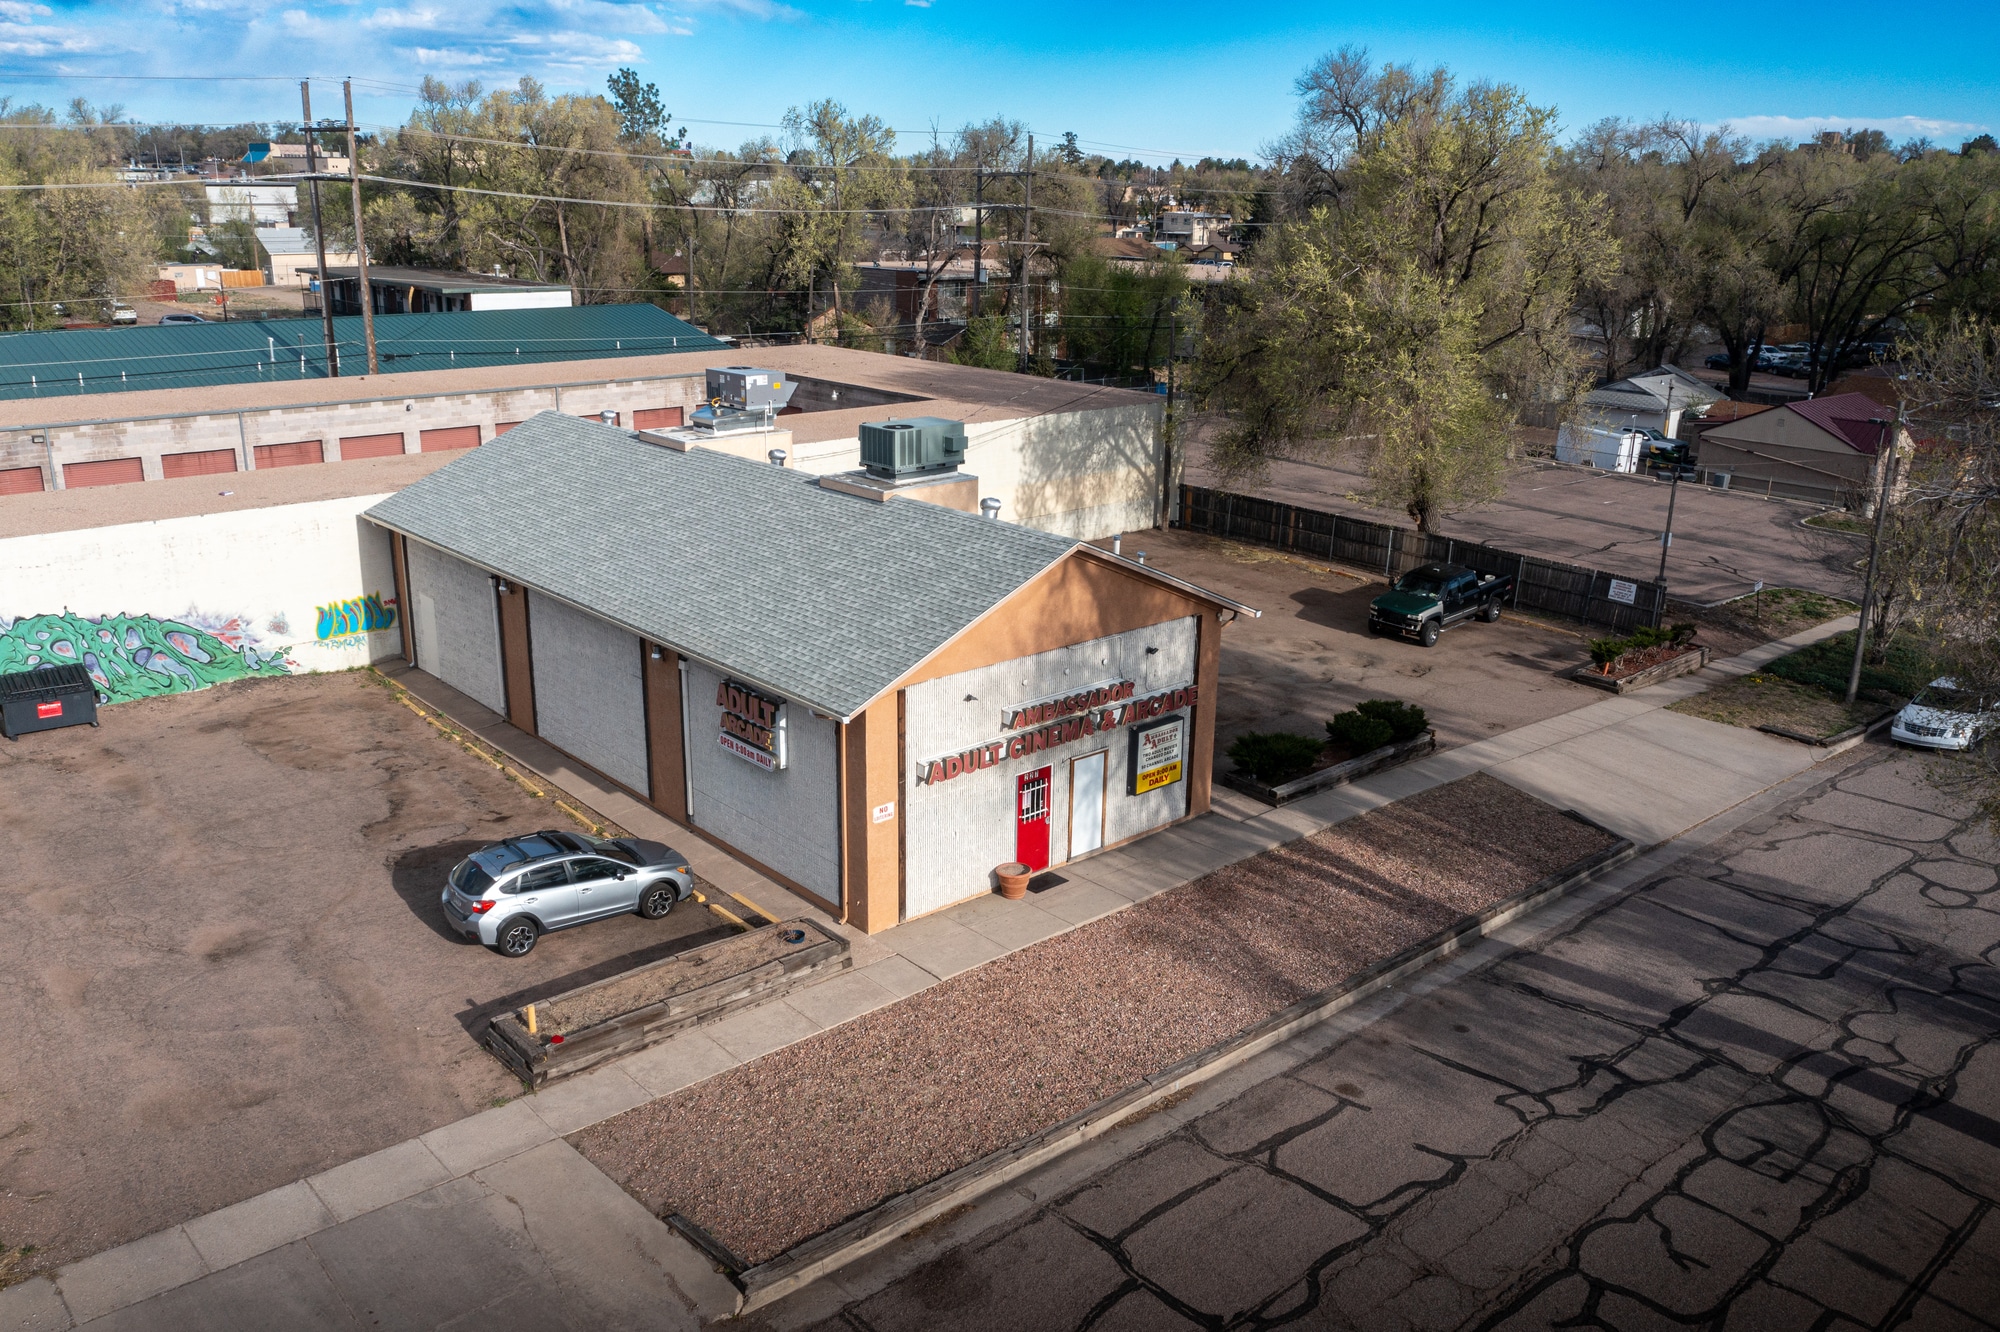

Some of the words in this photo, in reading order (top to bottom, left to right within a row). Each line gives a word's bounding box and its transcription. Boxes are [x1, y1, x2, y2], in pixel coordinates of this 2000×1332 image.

[716, 683, 775, 729] ADULT
[1012, 681, 1135, 730] AMBASSADOR
[720, 711, 773, 751] ARCADE
[928, 743, 1004, 786] ADULT
[1009, 715, 1094, 760] CINEMA
[1100, 709, 1117, 732] &
[1122, 685, 1199, 726] ARCADE
[720, 735, 734, 749] OPEN
[756, 753, 772, 768] DAILY
[1142, 771, 1156, 781] OPEN
[1169, 764, 1177, 772] AM
[1149, 773, 1170, 786] DAILY
[879, 805, 888, 814] NO
